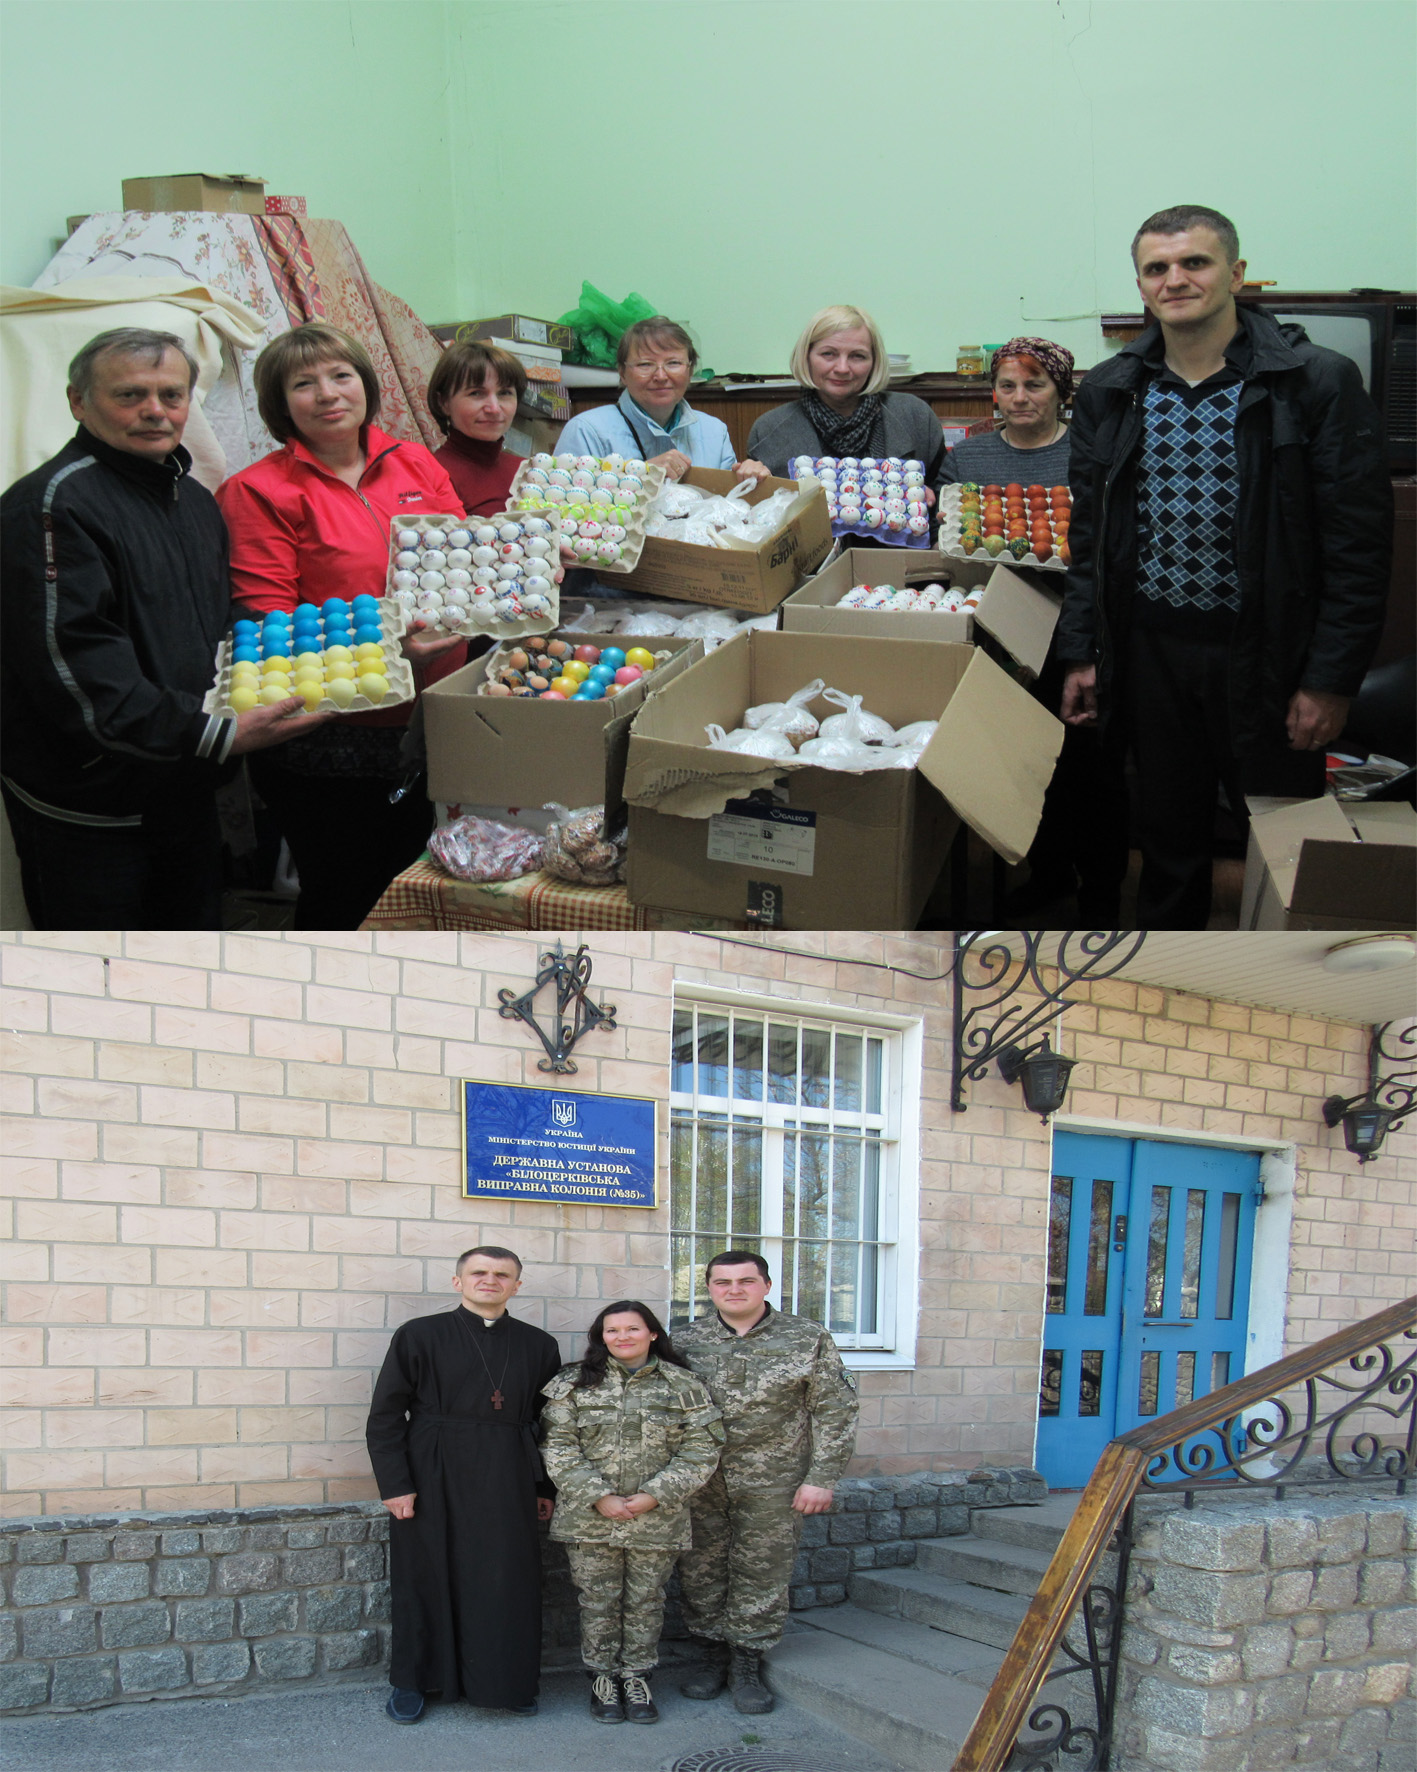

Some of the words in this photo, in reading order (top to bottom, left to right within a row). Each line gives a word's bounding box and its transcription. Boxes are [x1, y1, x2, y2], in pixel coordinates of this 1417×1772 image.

[781, 814, 809, 823] GALECO
[764, 846, 774, 854] 10
[761, 889, 775, 924] LECO
[544, 1128, 583, 1139] УКРАЇНА
[488, 1136, 556, 1148] МІНІСТЕРСТВО
[558, 1142, 597, 1152] ЮСТИЦІЇ
[598, 1145, 636, 1155] УКРАЇНИ
[493, 1155, 565, 1170] ДЕРЖАВНА
[567, 1161, 632, 1175] УСТАНОВА
[505, 1168, 620, 1186] «БІЛОЦЕРКІВСЬКА
[477, 1179, 548, 1193] ВИПРАВНА
[551, 1184, 607, 1197] КОЛОНІЯ
[609, 1189, 646, 1200] (№35)»
